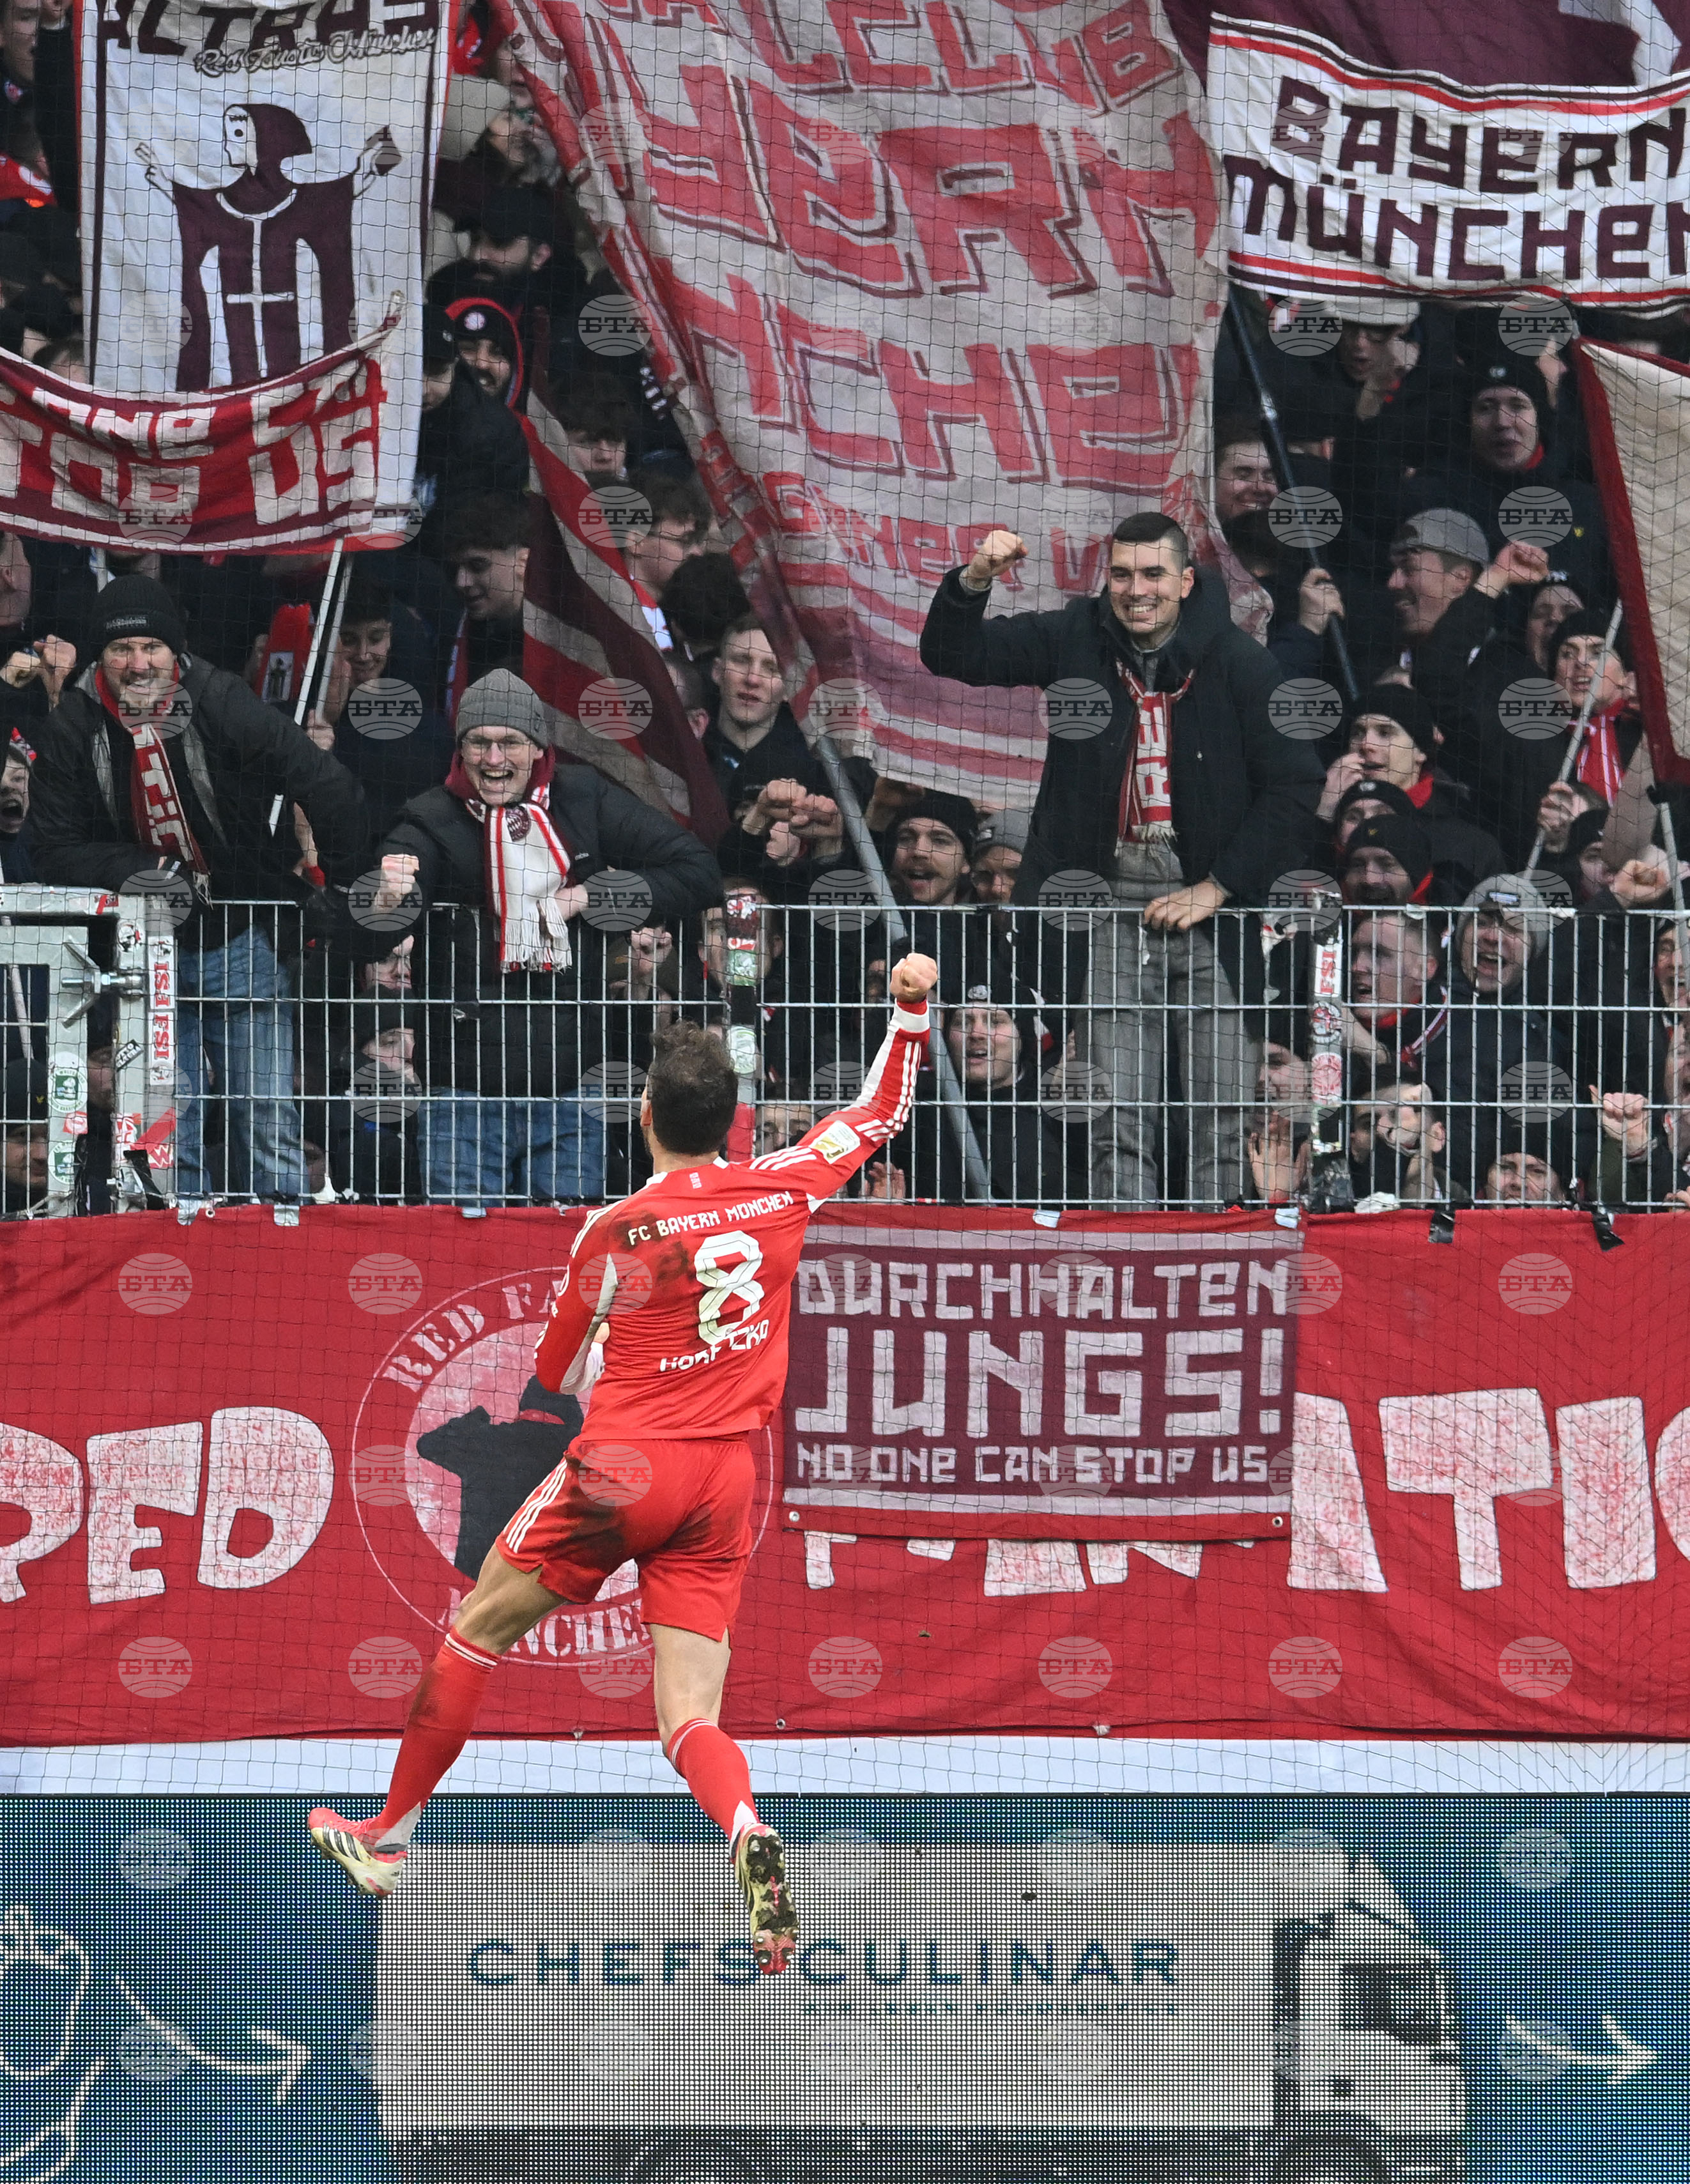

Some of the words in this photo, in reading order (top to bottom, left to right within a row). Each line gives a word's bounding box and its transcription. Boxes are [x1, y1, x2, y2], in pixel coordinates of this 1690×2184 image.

[1271, 75, 1686, 193] BAYERN
[154, 1013, 171, 1060] FSI
[628, 1225, 652, 1246] FC
[656, 1210, 721, 1238] BAYERN
[694, 1229, 765, 1346] 8
[797, 1259, 1289, 1320] DURCHHALTEN
[383, 1302, 484, 1393] RED
[794, 1327, 1285, 1438] JUNGS!
[796, 1442, 852, 1482] NO
[870, 1445, 956, 1484] ONE
[974, 1445, 1058, 1484] CAN
[1073, 1446, 1196, 1485] STOP
[1211, 1445, 1267, 1484] US
[467, 1938, 760, 1985] CHEFS
[798, 1938, 1179, 1985] CULINAR
